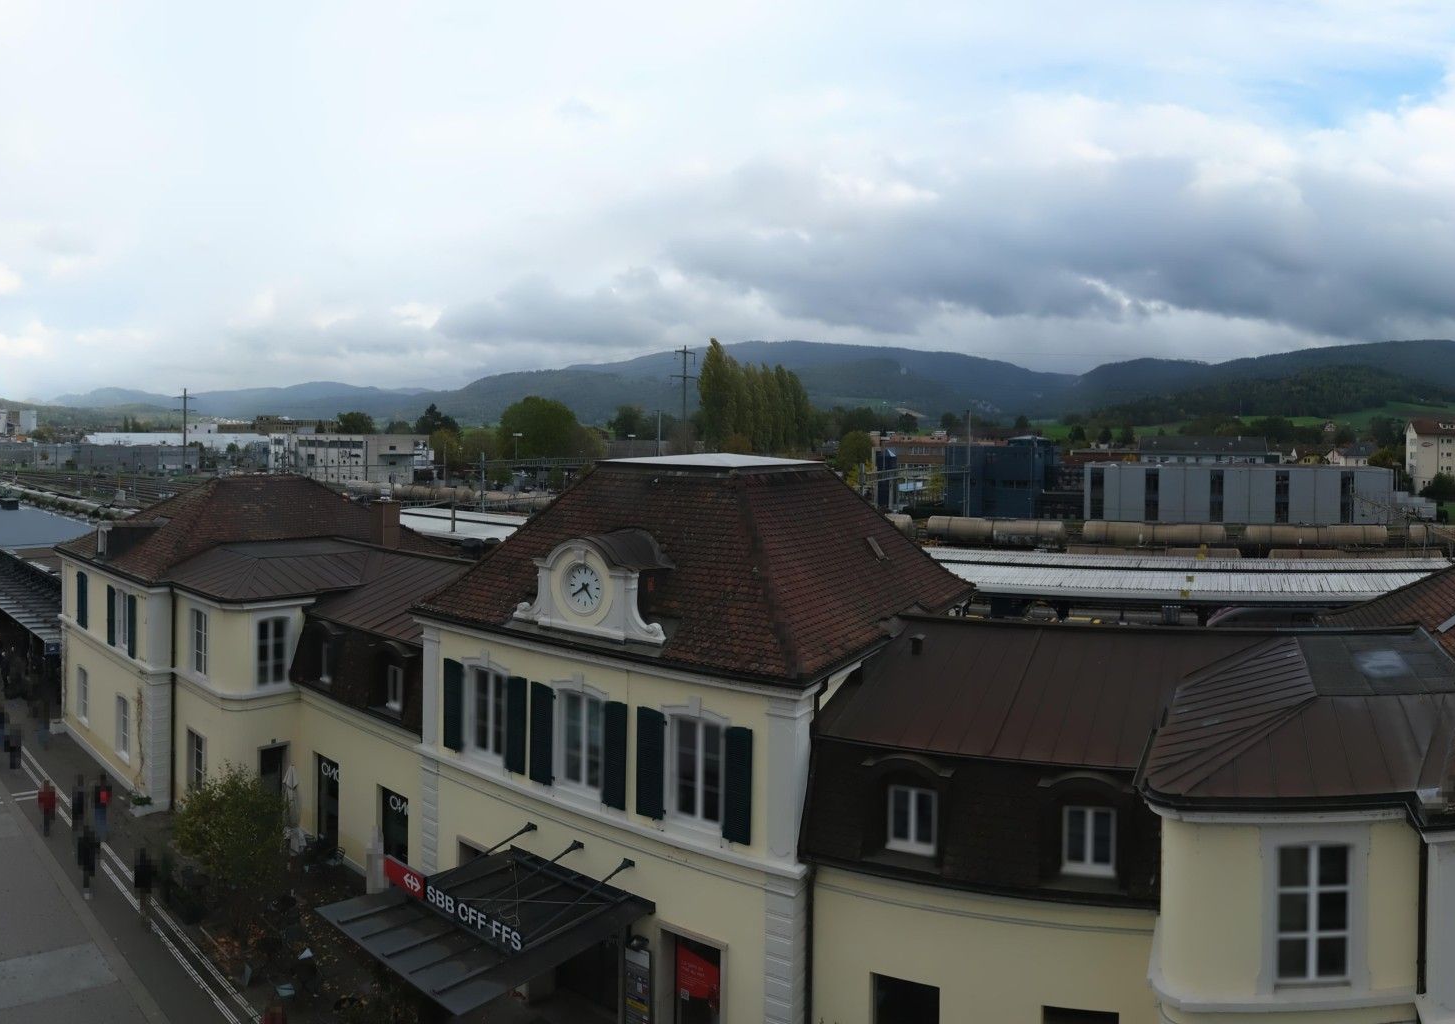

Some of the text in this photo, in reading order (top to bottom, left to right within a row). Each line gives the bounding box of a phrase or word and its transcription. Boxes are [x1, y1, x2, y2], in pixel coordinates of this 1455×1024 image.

[426, 885, 522, 951] SBB CFF FFS
